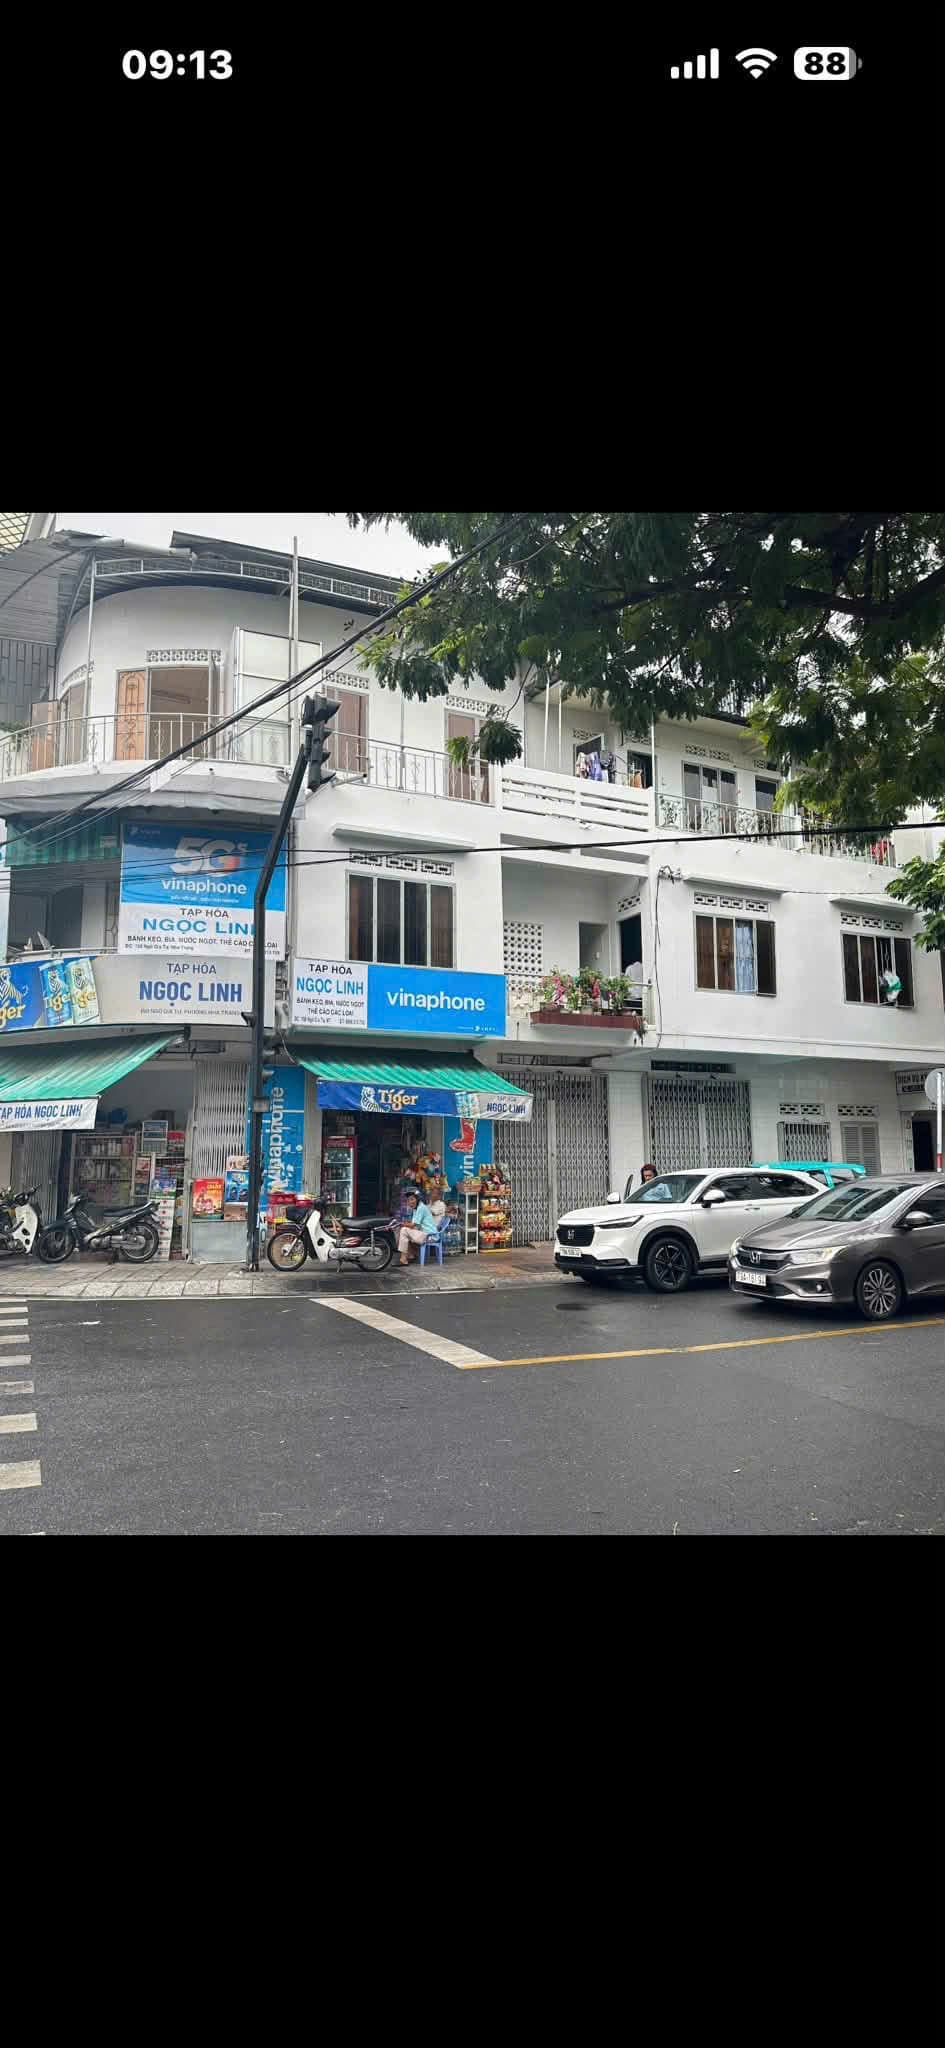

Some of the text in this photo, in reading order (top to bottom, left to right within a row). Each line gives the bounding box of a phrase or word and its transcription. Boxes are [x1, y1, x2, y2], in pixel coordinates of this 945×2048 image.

[161, 878, 247, 894] vinaphone
[180, 908, 202, 921] TẠP
[143, 918, 207, 934] NGỌC
[167, 962, 217, 976] TẠP HÓA
[308, 963, 328, 974] TẠP
[139, 981, 242, 1007] NGỌC LINH
[297, 977, 363, 995] NGỌC LINH
[386, 988, 485, 1011] vinaphone
[34, 1105, 59, 1121] NGỌC
[60, 1104, 82, 1117] LINH
[509, 1104, 526, 1114] LINH
